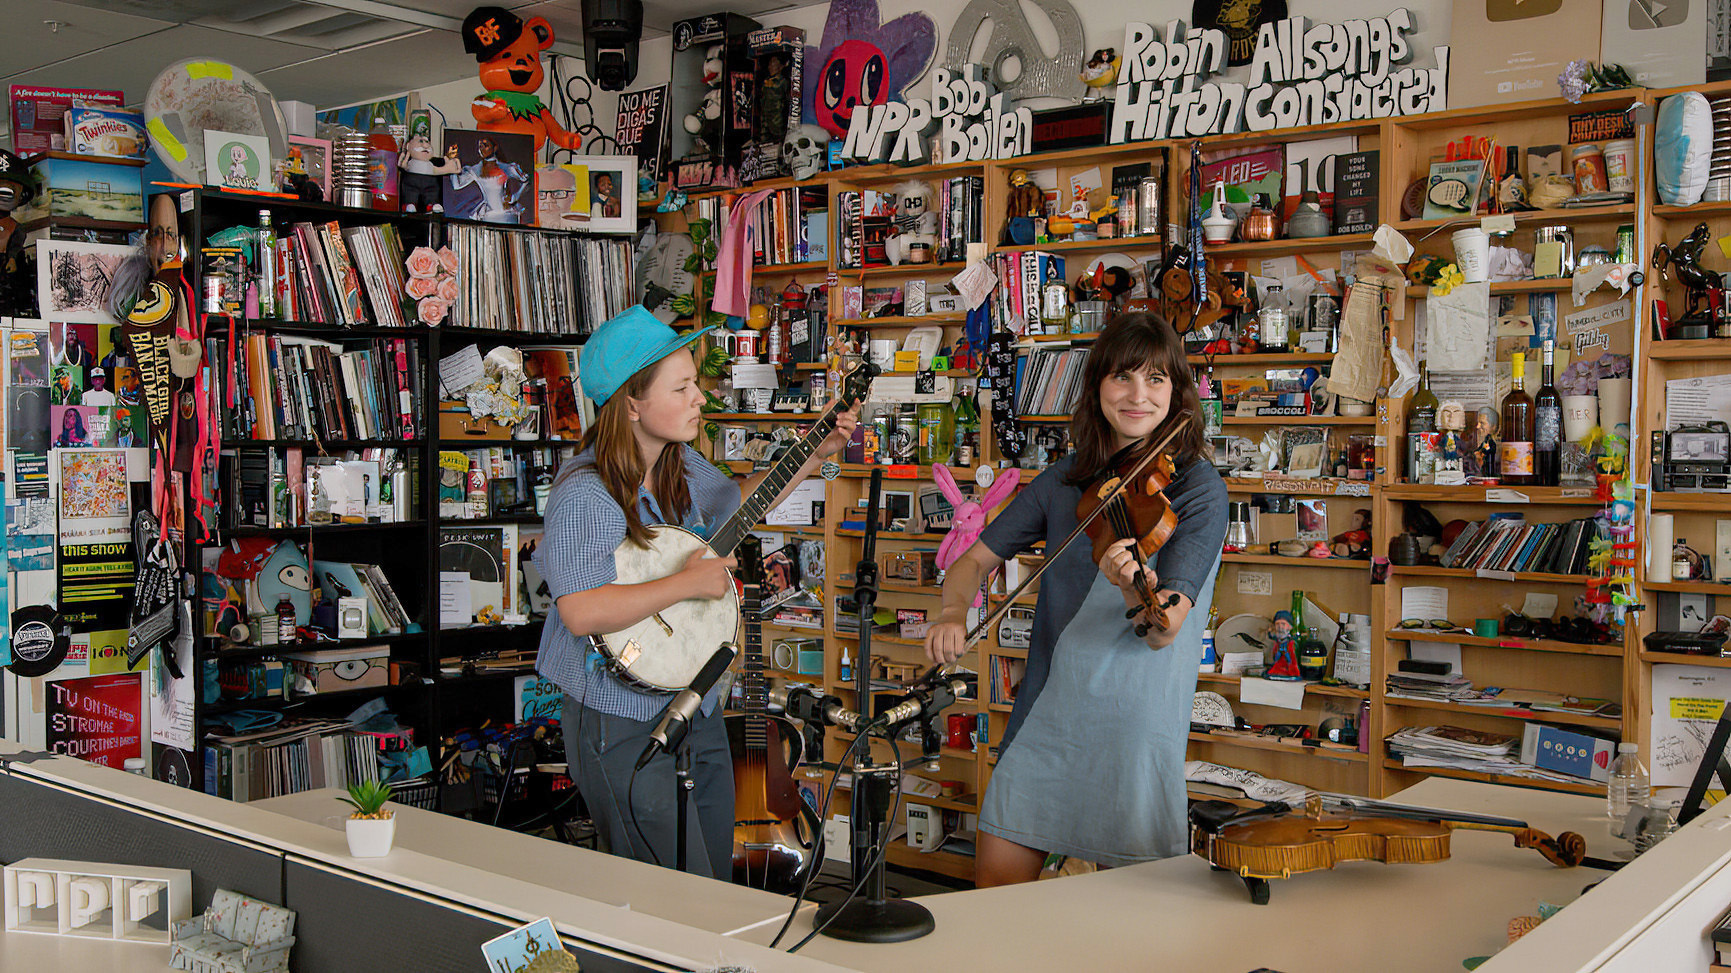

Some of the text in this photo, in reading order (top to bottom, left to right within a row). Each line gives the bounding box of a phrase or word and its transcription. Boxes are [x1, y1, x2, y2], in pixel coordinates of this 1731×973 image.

[1119, 19, 1229, 85] Robin
[1250, 8, 1413, 88] Allsongs
[931, 63, 989, 118] Bob
[1245, 45, 1450, 131] Considered
[619, 89, 661, 112] NO ME
[1110, 74, 1247, 144] Hilton
[617, 108, 655, 130] DIGAS
[943, 92, 1033, 164] Boilen
[1571, 114, 1624, 133] TINY DESK
[79, 120, 128, 142] Twinkies
[616, 127, 642, 145] QUE
[840, 99, 932, 162] NPR
[1570, 129, 1616, 143] CONTEST
[1348, 164, 1366, 173] SONG
[1349, 156, 1366, 165] YOUR
[225, 176, 259, 189] Louie
[1223, 161, 1250, 185] LED
[1342, 172, 1371, 182] CHANGED
[1349, 189, 1363, 197] LIFE
[1352, 181, 1361, 189] MY
[1337, 223, 1374, 234] BOB BOILEN
[1025, 252, 1037, 281] THIS
[1027, 306, 1038, 333] CALL
[128, 331, 162, 425] BANJO MAGIC
[153, 334, 170, 419] BLACK GIRL
[1258, 407, 1306, 415] BROCCOLI
[444, 533, 496, 542] DESK UNIT
[62, 543, 127, 557] this show
[51, 683, 78, 707] TV
[83, 696, 101, 714] ON
[103, 703, 118, 719] THE
[52, 713, 114, 733] STROMAE
[52, 736, 119, 756] COURTNEY
[18, 871, 164, 929] npr
